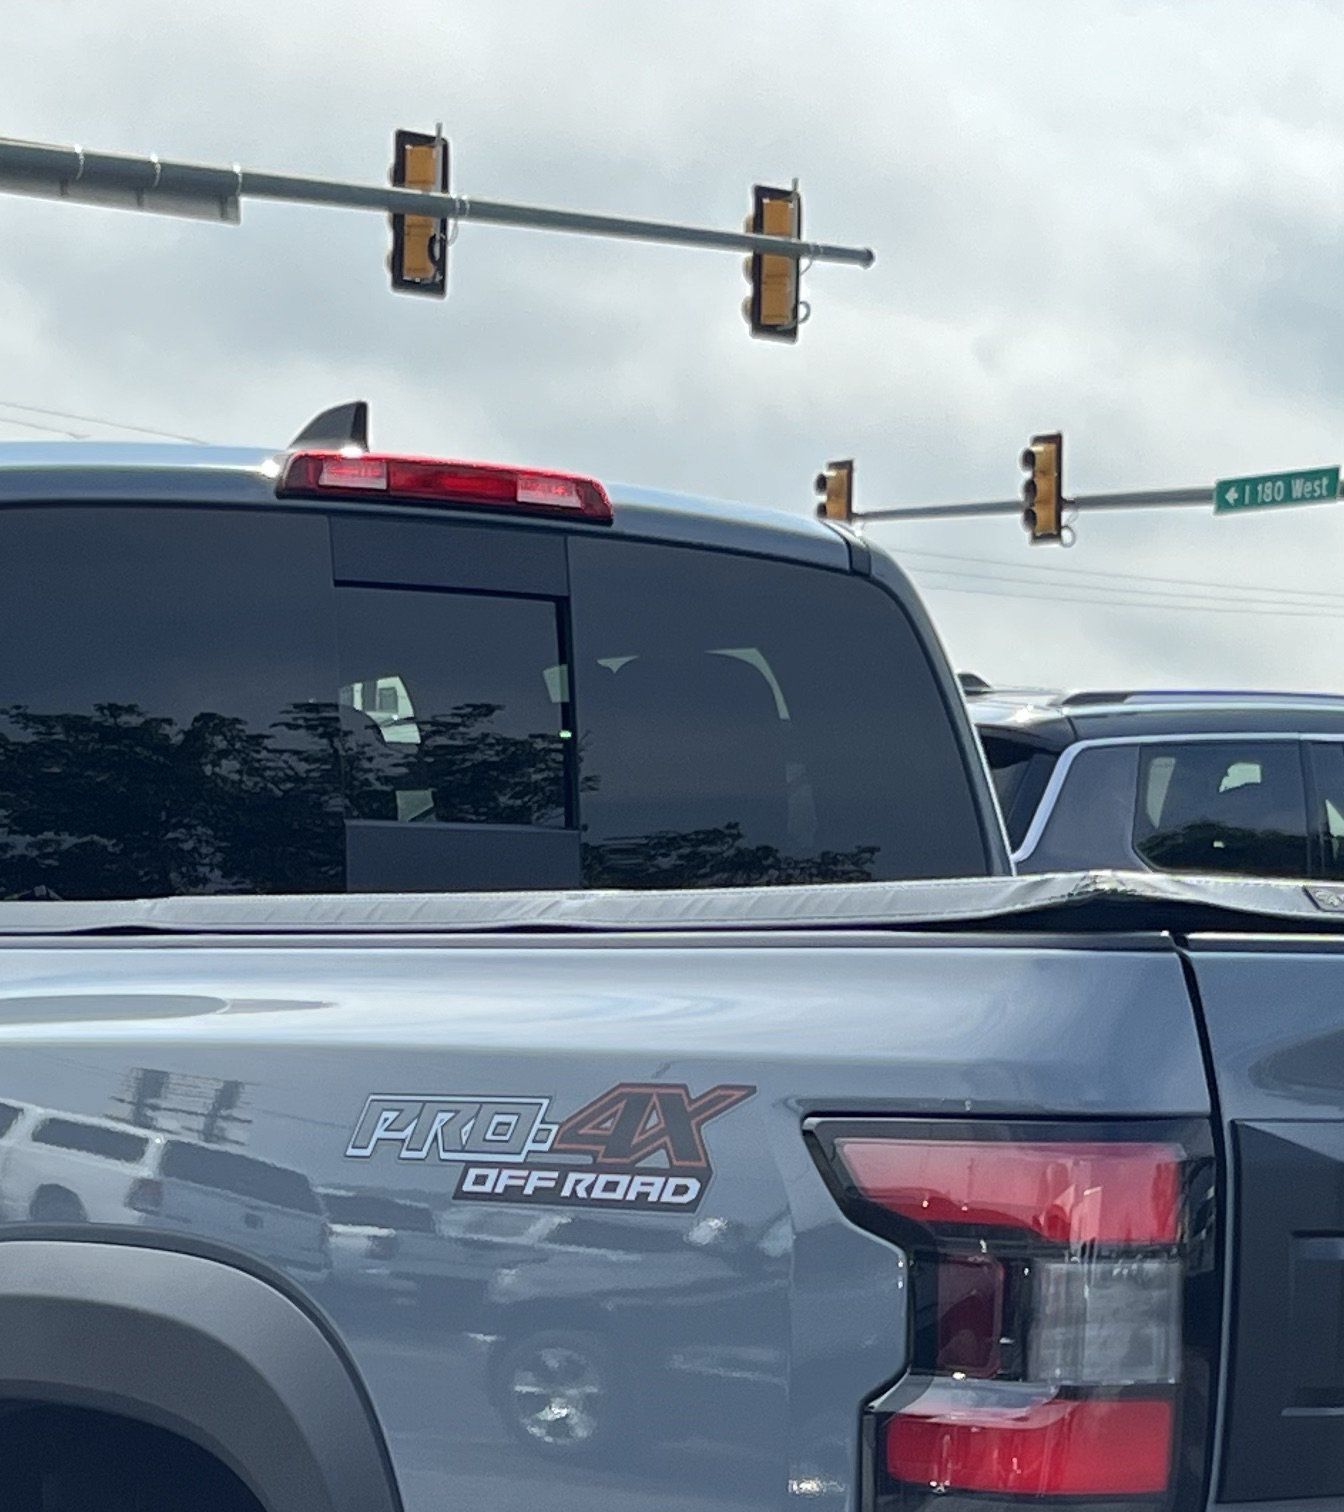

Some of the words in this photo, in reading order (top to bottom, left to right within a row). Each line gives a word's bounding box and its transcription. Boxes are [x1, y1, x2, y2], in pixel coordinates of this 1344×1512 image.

[1257, 480, 1284, 503] 180
[1291, 476, 1329, 498] West
[461, 1168, 557, 1196] OFF
[560, 1171, 702, 1203] ROAD
